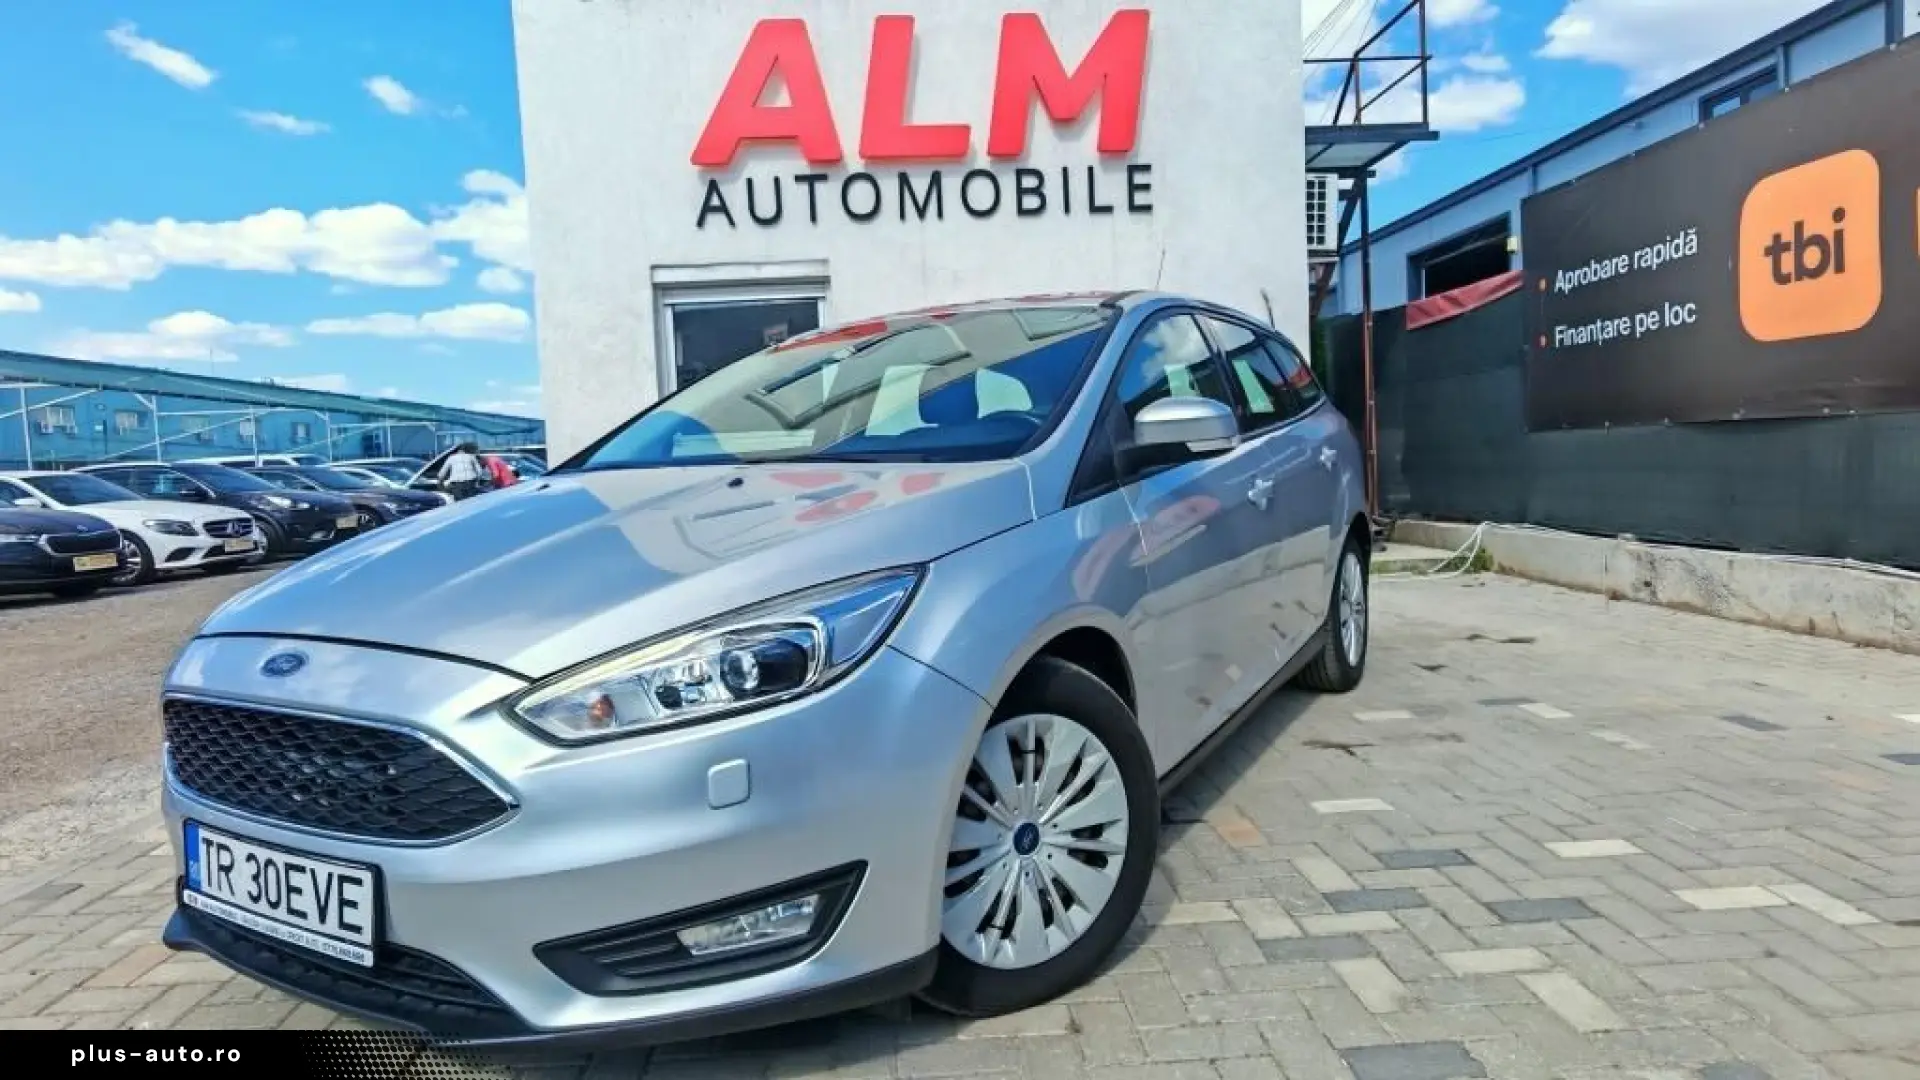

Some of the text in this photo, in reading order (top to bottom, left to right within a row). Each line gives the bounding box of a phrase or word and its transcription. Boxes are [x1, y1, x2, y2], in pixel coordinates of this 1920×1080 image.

[691, 9, 1150, 165] ALM
[697, 164, 1153, 228] AUTOMOBILE
[1554, 227, 1698, 294] Aprobare rapidă
[1764, 207, 1846, 285] tbi
[1635, 310, 1660, 338] pe
[1665, 301, 1696, 327] loc
[203, 837, 235, 896] TR
